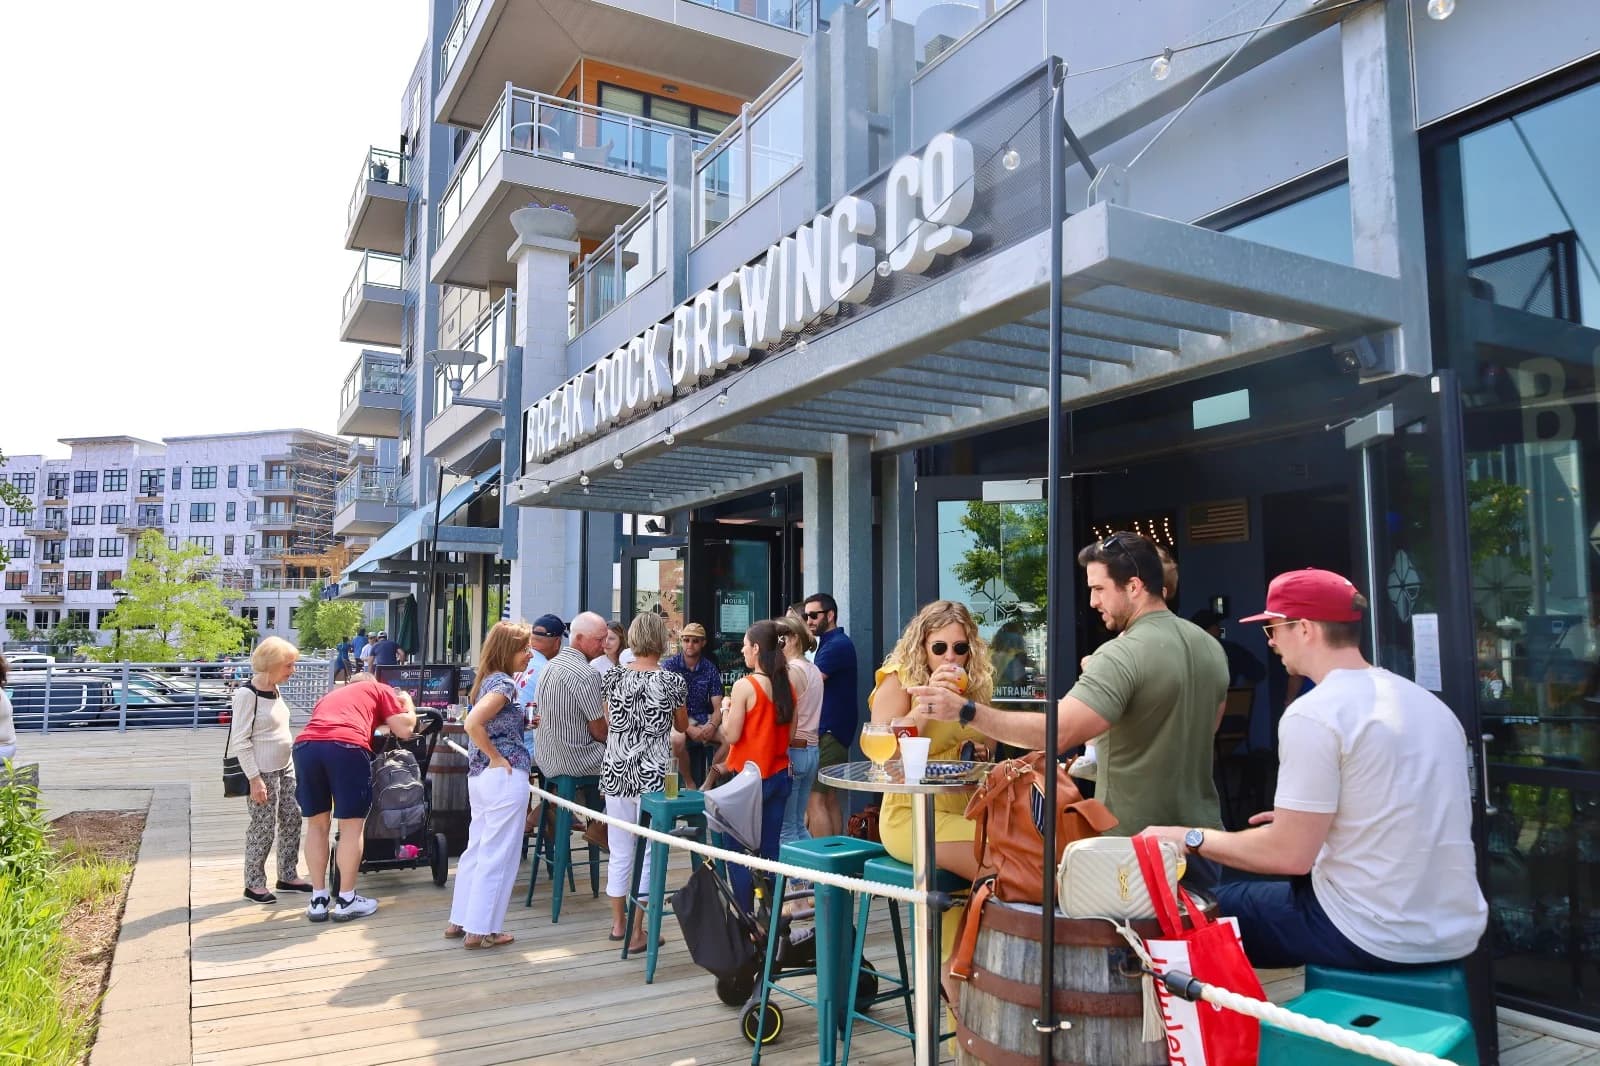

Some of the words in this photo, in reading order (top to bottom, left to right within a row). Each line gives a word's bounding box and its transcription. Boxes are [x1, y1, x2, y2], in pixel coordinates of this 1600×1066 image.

[526, 373, 594, 464] BREAK
[594, 323, 672, 429] ROCK
[673, 196, 876, 387] BREWING
[1519, 350, 1600, 456] B
